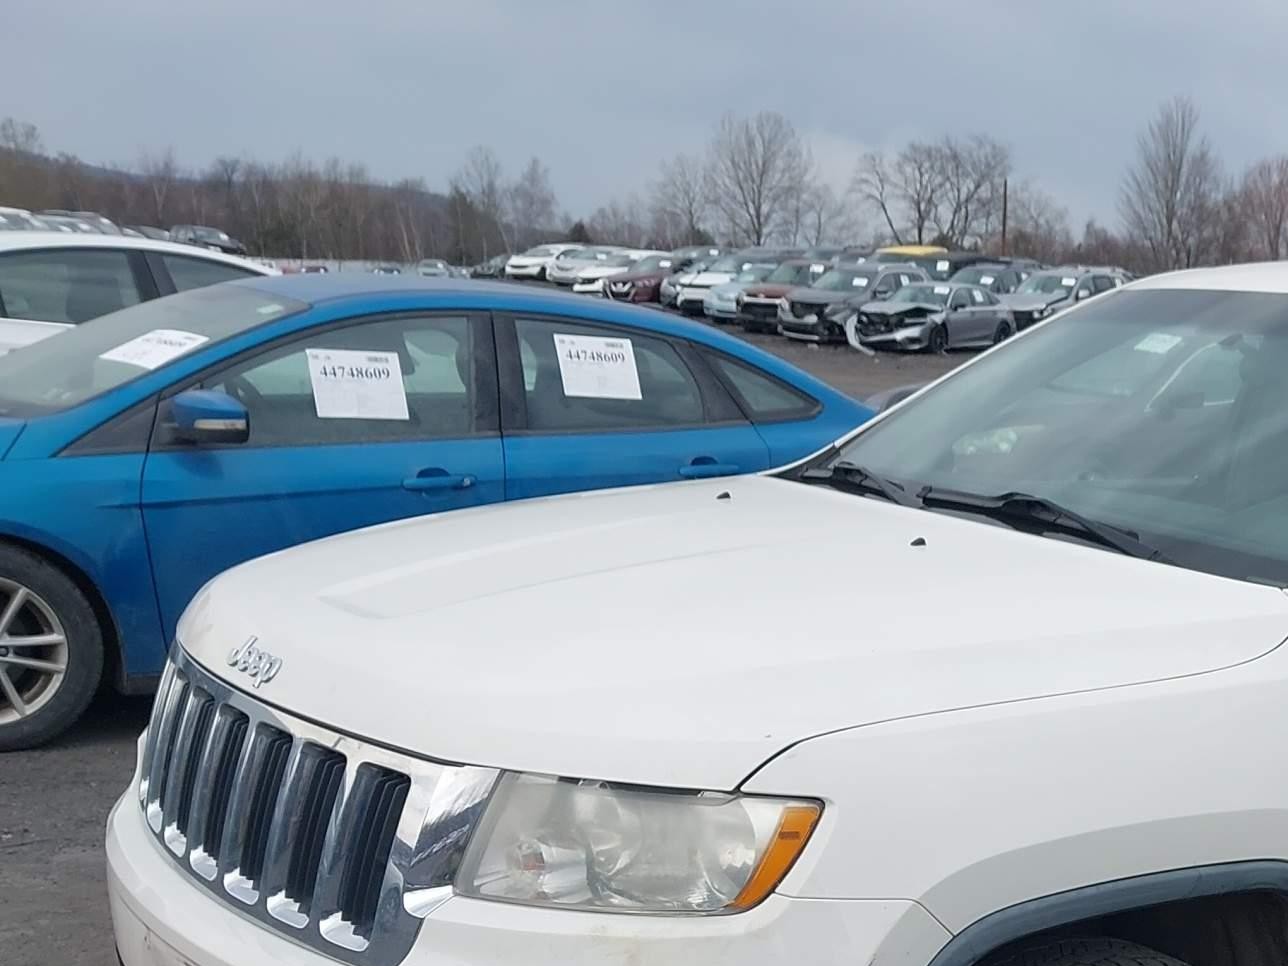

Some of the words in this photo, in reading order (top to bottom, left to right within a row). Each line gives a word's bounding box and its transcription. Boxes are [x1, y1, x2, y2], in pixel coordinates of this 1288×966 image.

[565, 349, 626, 363] 44748609
[319, 365, 391, 379] 44748609
[226, 635, 283, 689] Jeep
